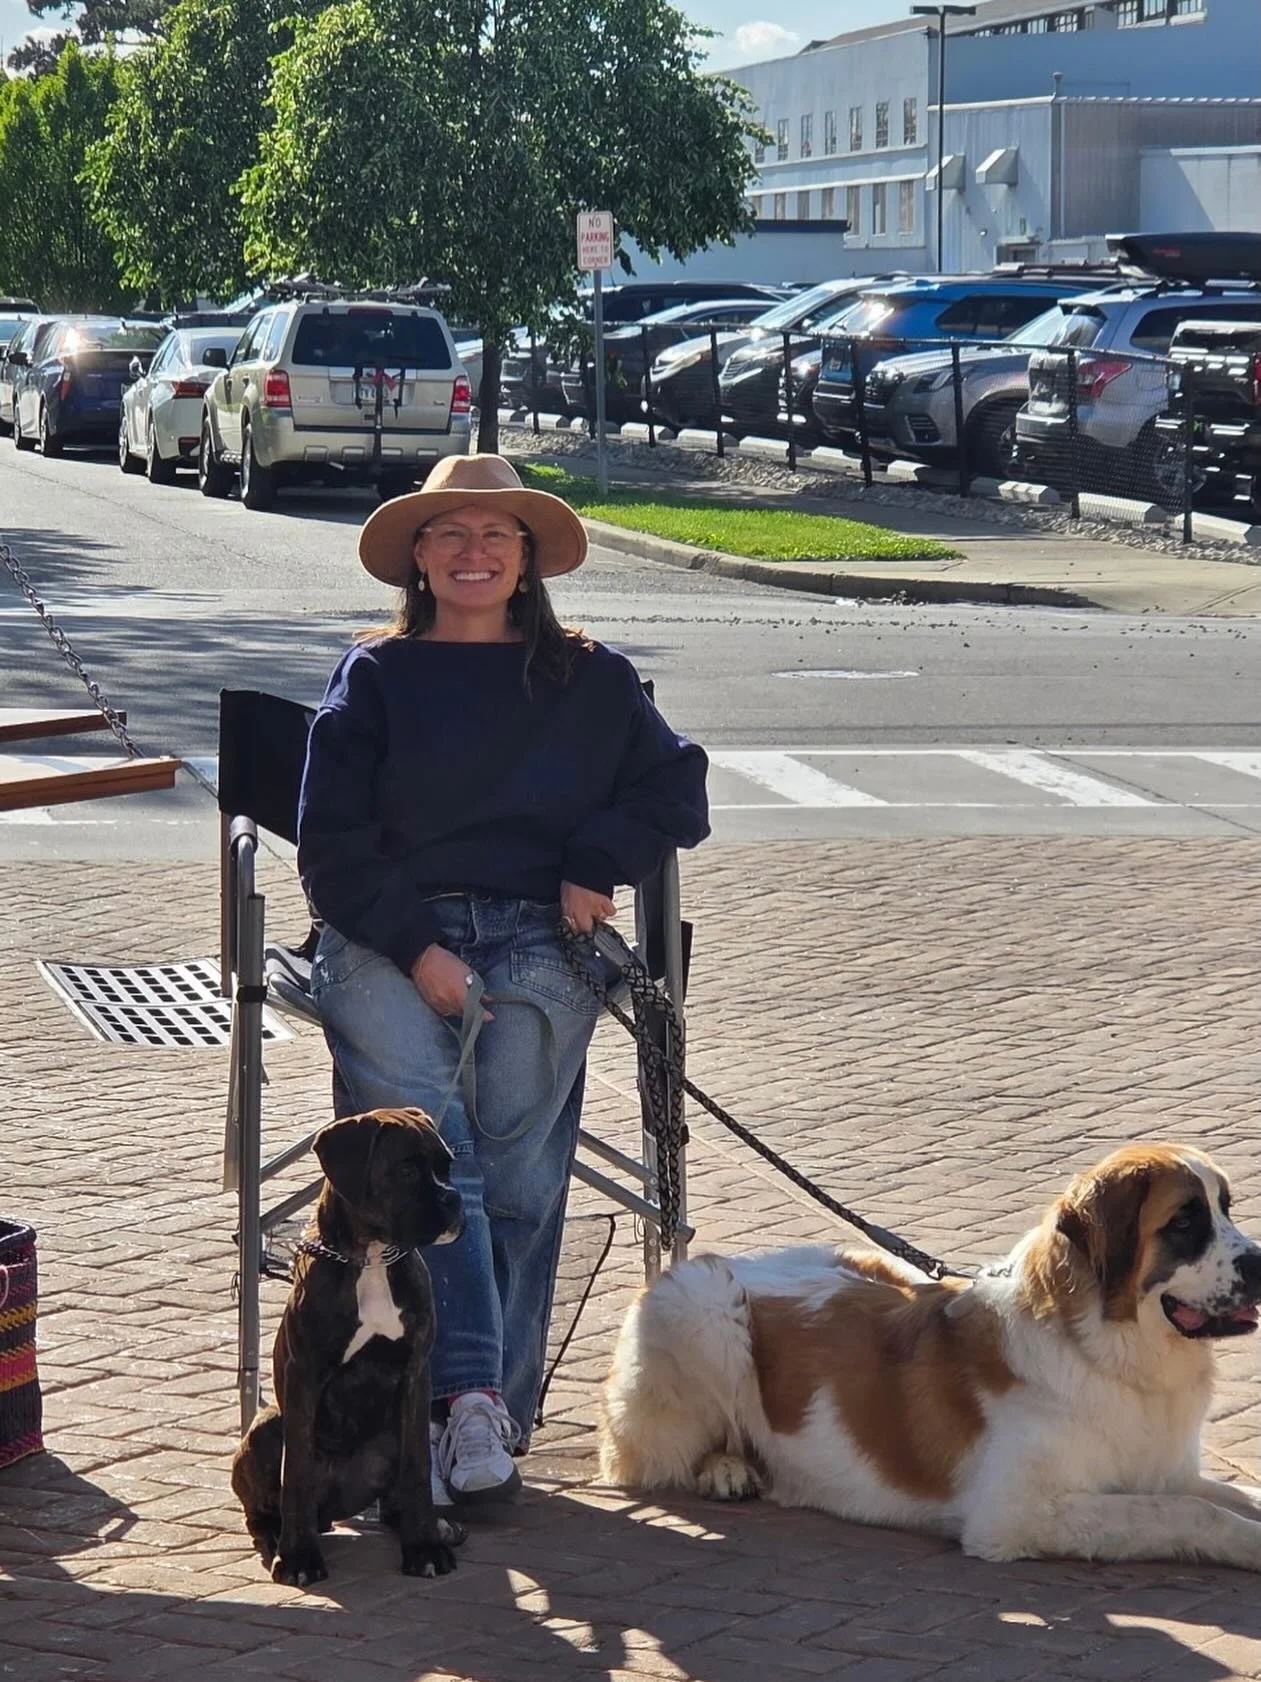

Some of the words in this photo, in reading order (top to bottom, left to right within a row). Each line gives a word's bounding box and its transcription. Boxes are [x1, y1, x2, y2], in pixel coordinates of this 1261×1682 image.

[588, 217, 602, 228] NO
[581, 231, 609, 242] PARKING
[583, 255, 608, 264] CORNER
